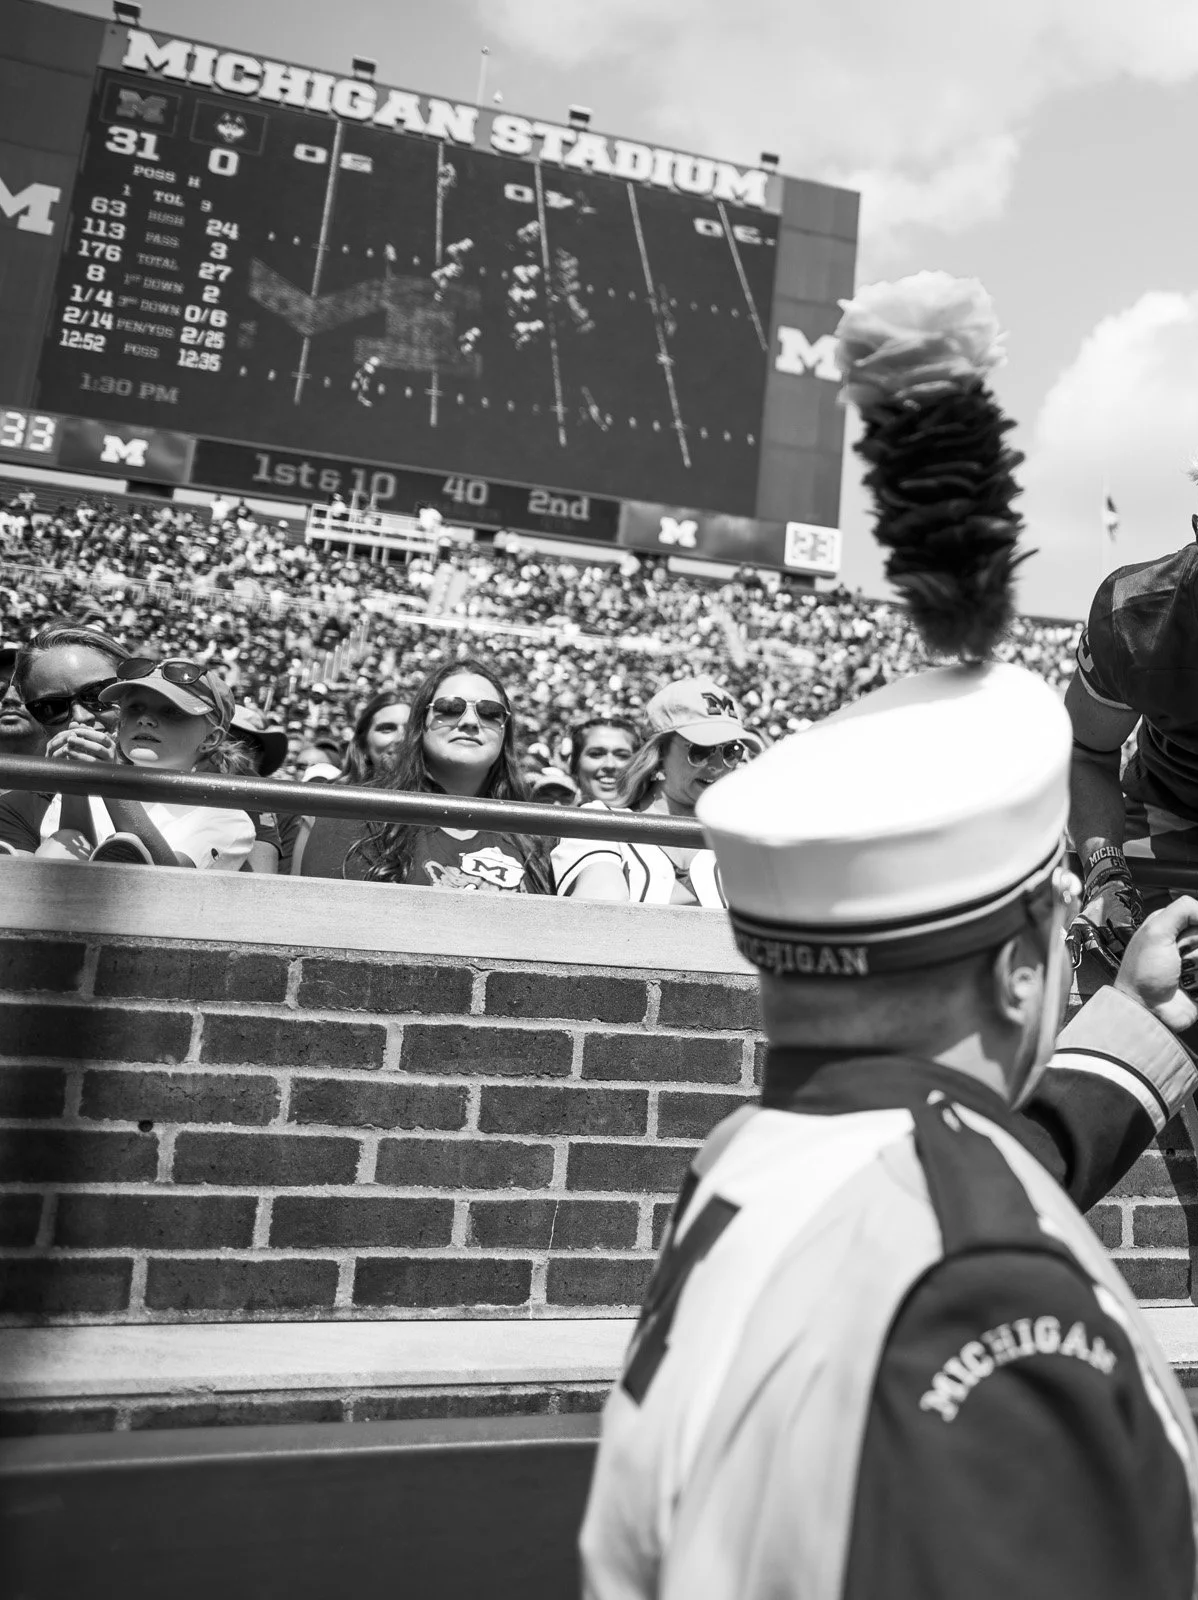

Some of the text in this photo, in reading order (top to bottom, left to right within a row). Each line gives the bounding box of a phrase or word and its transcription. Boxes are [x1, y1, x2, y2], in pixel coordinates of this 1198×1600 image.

[121, 28, 770, 208] MICHIGAN STADIUM
[105, 125, 240, 177] 31 0
[132, 164, 177, 183] POSS
[0, 177, 62, 236] M
[90, 196, 128, 218] 63
[205, 218, 239, 240] 24
[77, 238, 234, 282] 176 TOTAL 27
[81, 216, 229, 260] 113 PASS 3
[86, 263, 106, 282] 8
[202, 285, 221, 304] 2
[62, 305, 114, 331] 2/14
[180, 325, 226, 350] 2/25
[70, 284, 114, 308] 1/4
[184, 304, 229, 328] 0/6
[59, 328, 107, 353] 12:52
[778, 326, 842, 382] M
[137, 381, 181, 405] PM
[0, 409, 57, 452] 33
[101, 435, 149, 468] M
[442, 475, 489, 506] 40
[527, 489, 591, 521] 2nd
[659, 516, 699, 549] M
[700, 692, 739, 720] M
[471, 858, 509, 882] M
[919, 1315, 1117, 1423] MICHIGAN
